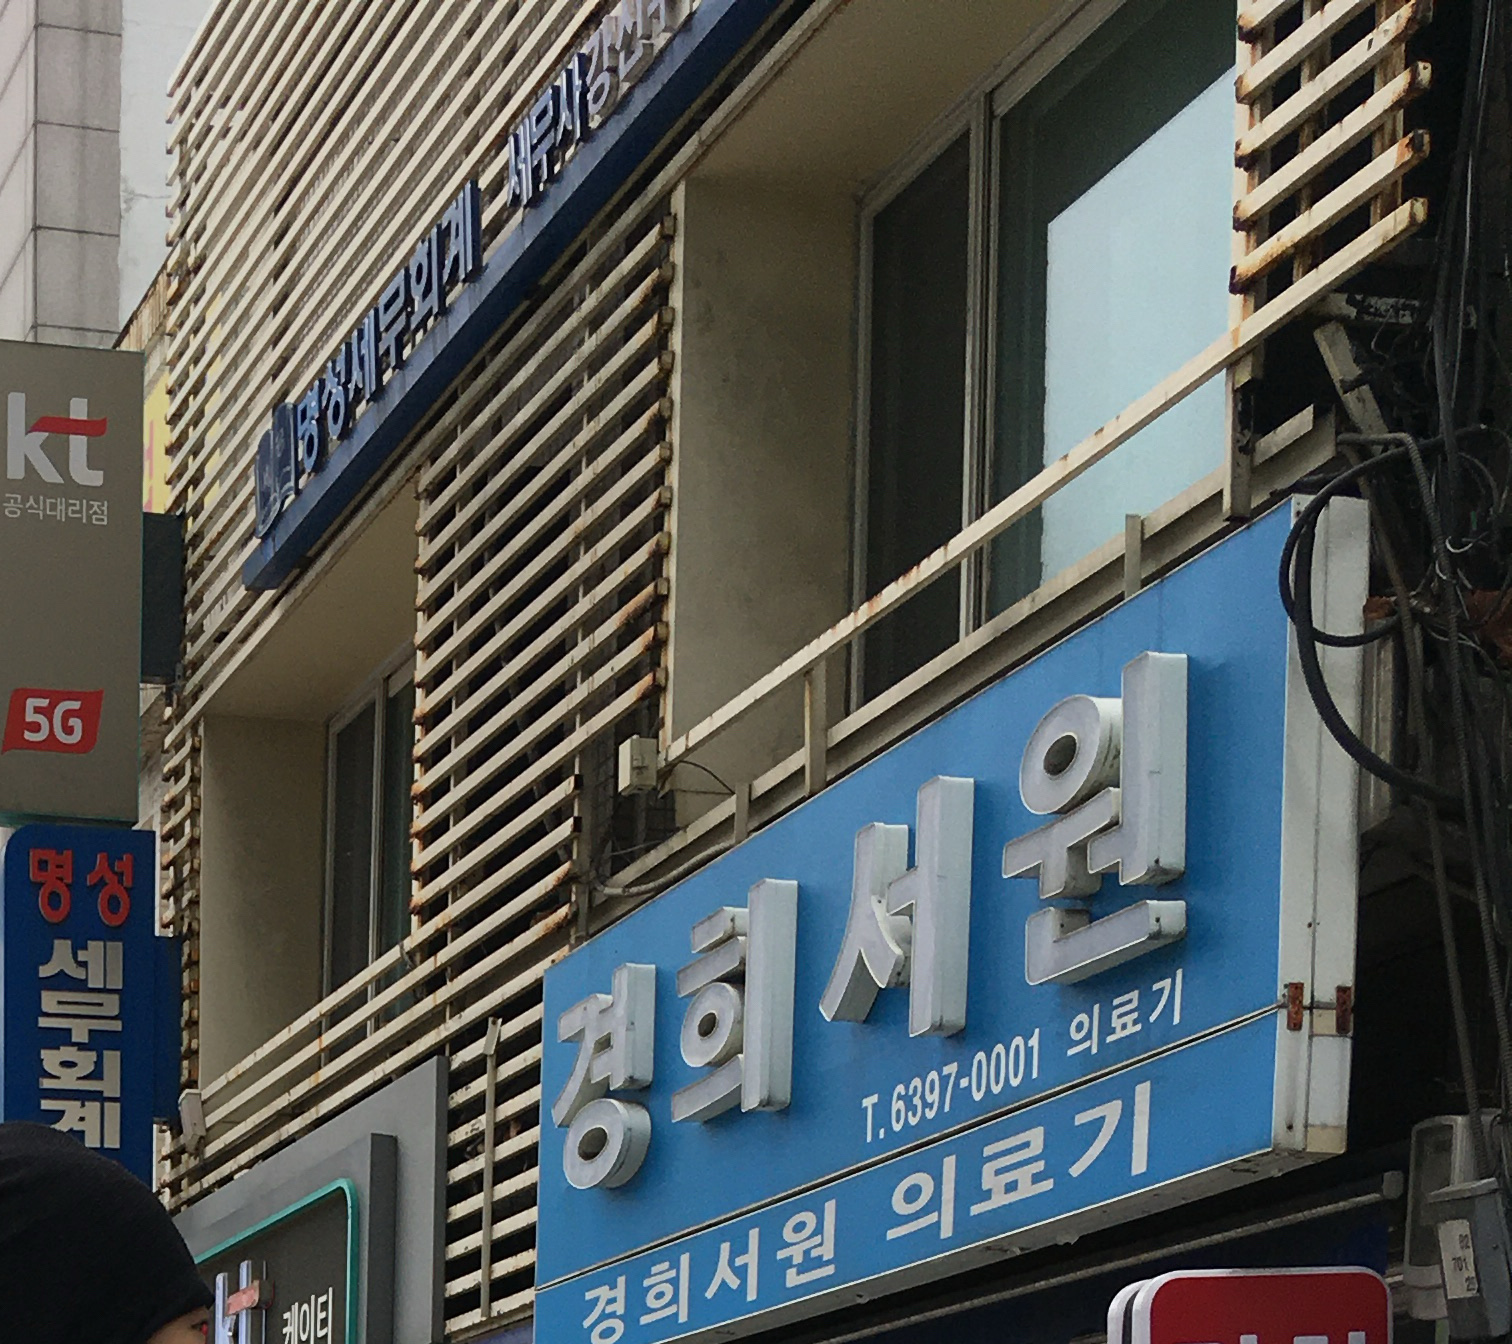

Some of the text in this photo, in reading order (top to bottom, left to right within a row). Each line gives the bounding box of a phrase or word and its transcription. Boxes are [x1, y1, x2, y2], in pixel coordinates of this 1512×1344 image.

[296, 179, 478, 474] 명성세무회계
[507, 53, 587, 207] 세무사
[7, 391, 107, 487] kt
[3, 494, 108, 525] 공식대리점
[23, 697, 83, 744] 5G
[29, 848, 133, 928] 명성
[552, 650, 1189, 1192] 경희서원
[37, 939, 122, 1149] 세무회계
[1068, 968, 1185, 1059] 의료기
[886, 1080, 1154, 1242] 의료기
